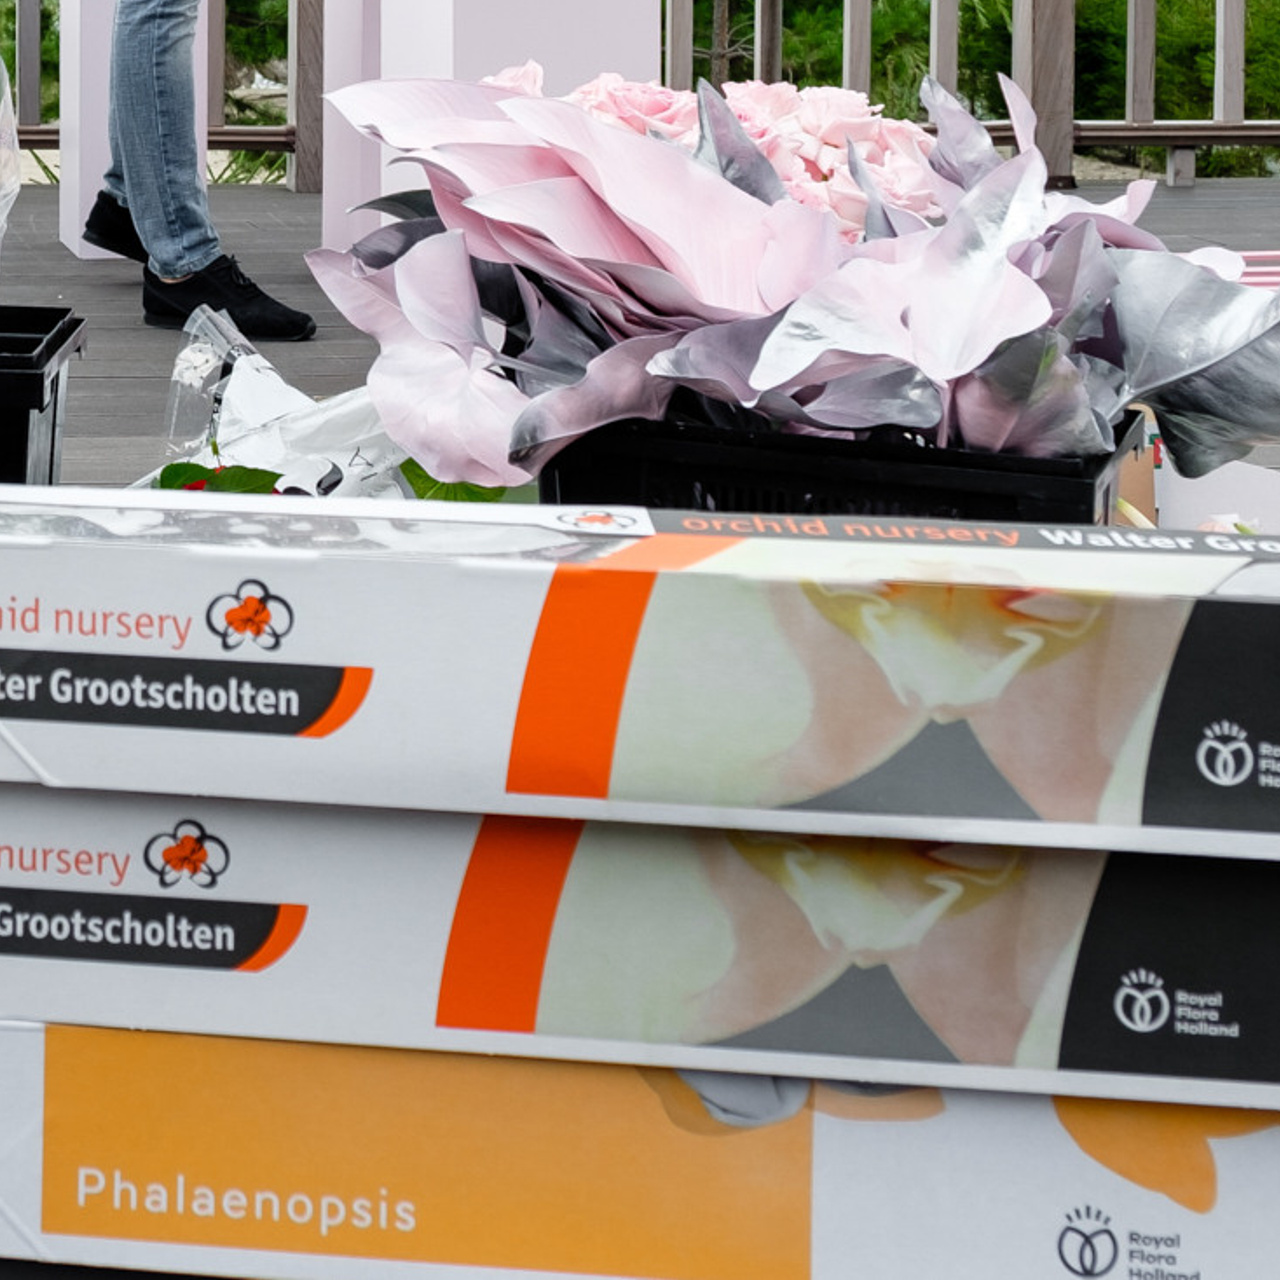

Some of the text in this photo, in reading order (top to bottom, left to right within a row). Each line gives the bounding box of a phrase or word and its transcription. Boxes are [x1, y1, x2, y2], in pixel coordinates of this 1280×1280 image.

[682, 515, 830, 536] orchid
[842, 523, 1019, 547] nursery
[1038, 528, 1194, 550] Walter
[54, 604, 192, 649] nursery
[49, 668, 300, 717] Grootscholten
[1175, 989, 1223, 1007] Royal
[1175, 1006, 1219, 1021] Flora
[1175, 1021, 1240, 1037] Holland
[76, 1166, 417, 1235] Phalaenopsis
[1128, 1231, 1181, 1250] Royal
[1128, 1249, 1177, 1266] Flora
